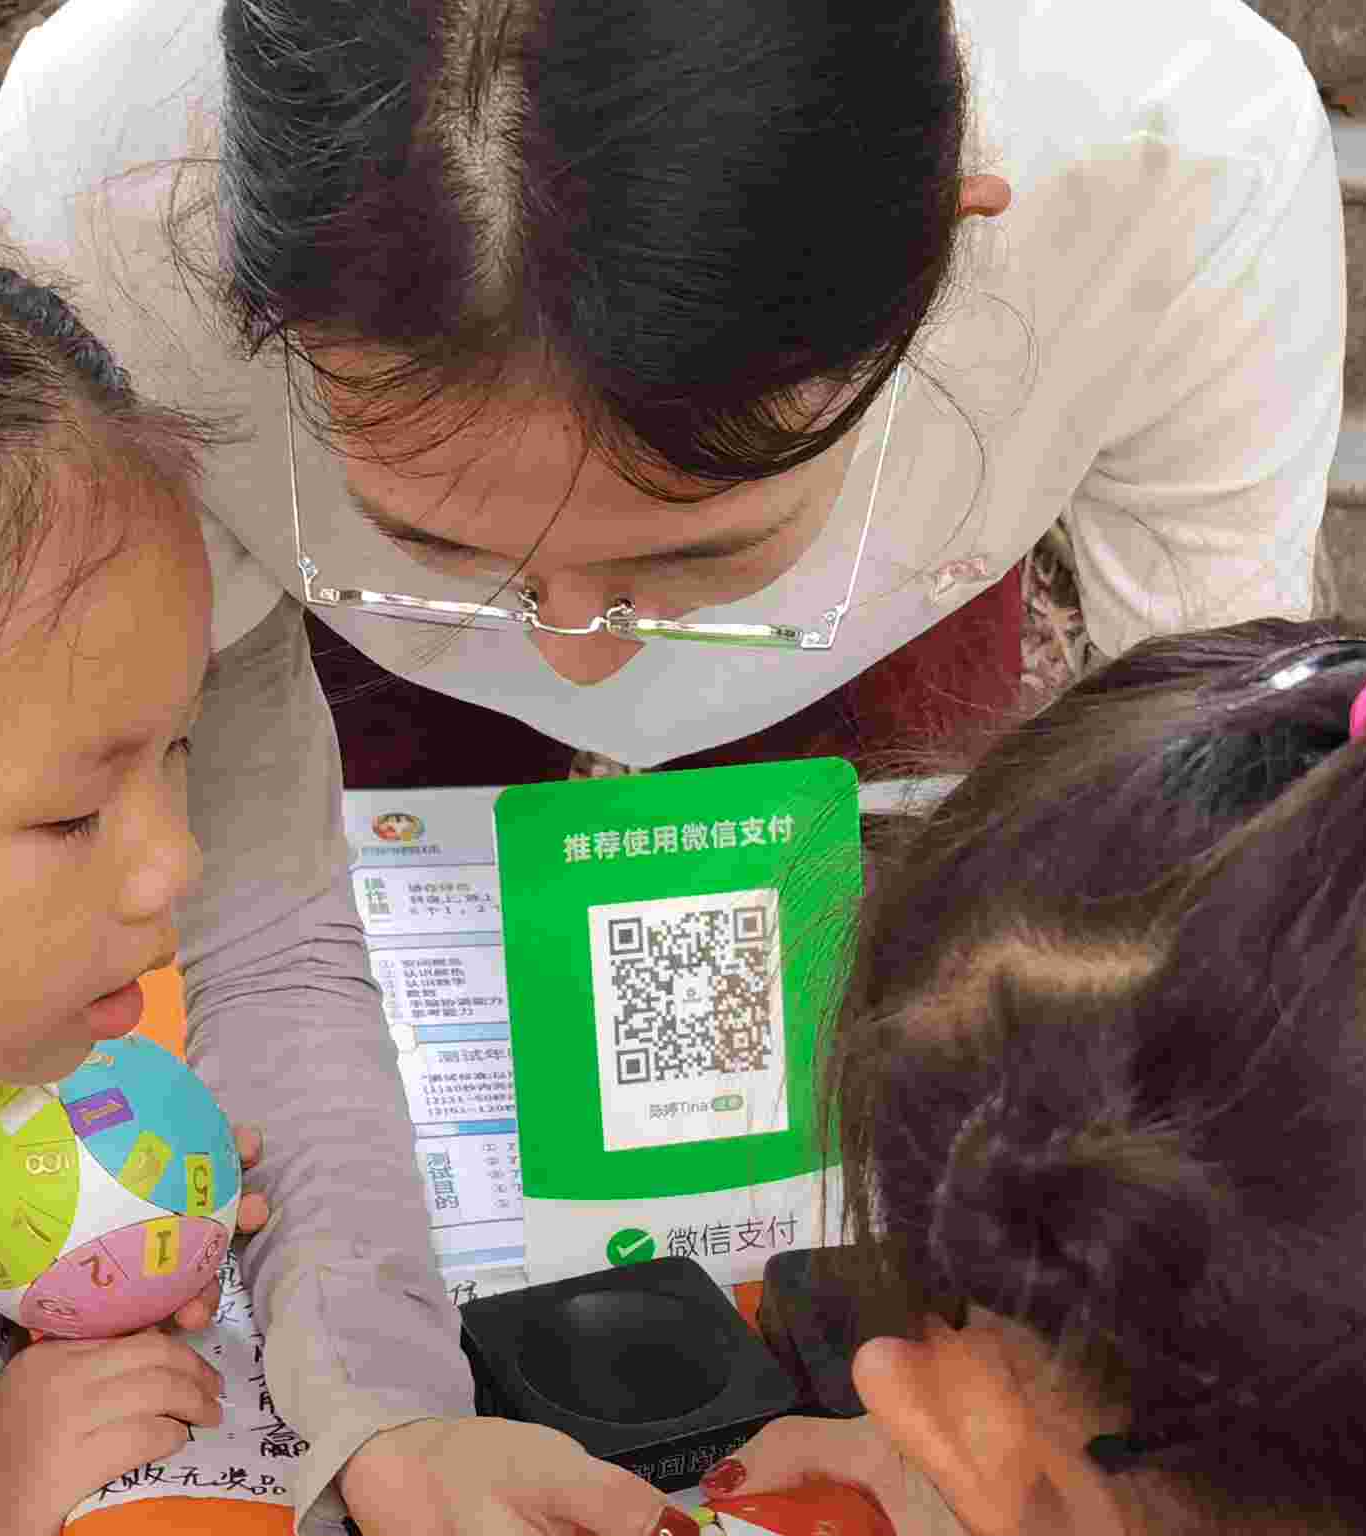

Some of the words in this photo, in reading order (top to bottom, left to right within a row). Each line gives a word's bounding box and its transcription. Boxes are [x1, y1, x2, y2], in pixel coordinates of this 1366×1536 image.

[563, 814, 795, 864] 推荐使用微信支付
[667, 1212, 799, 1258] 微信支付
